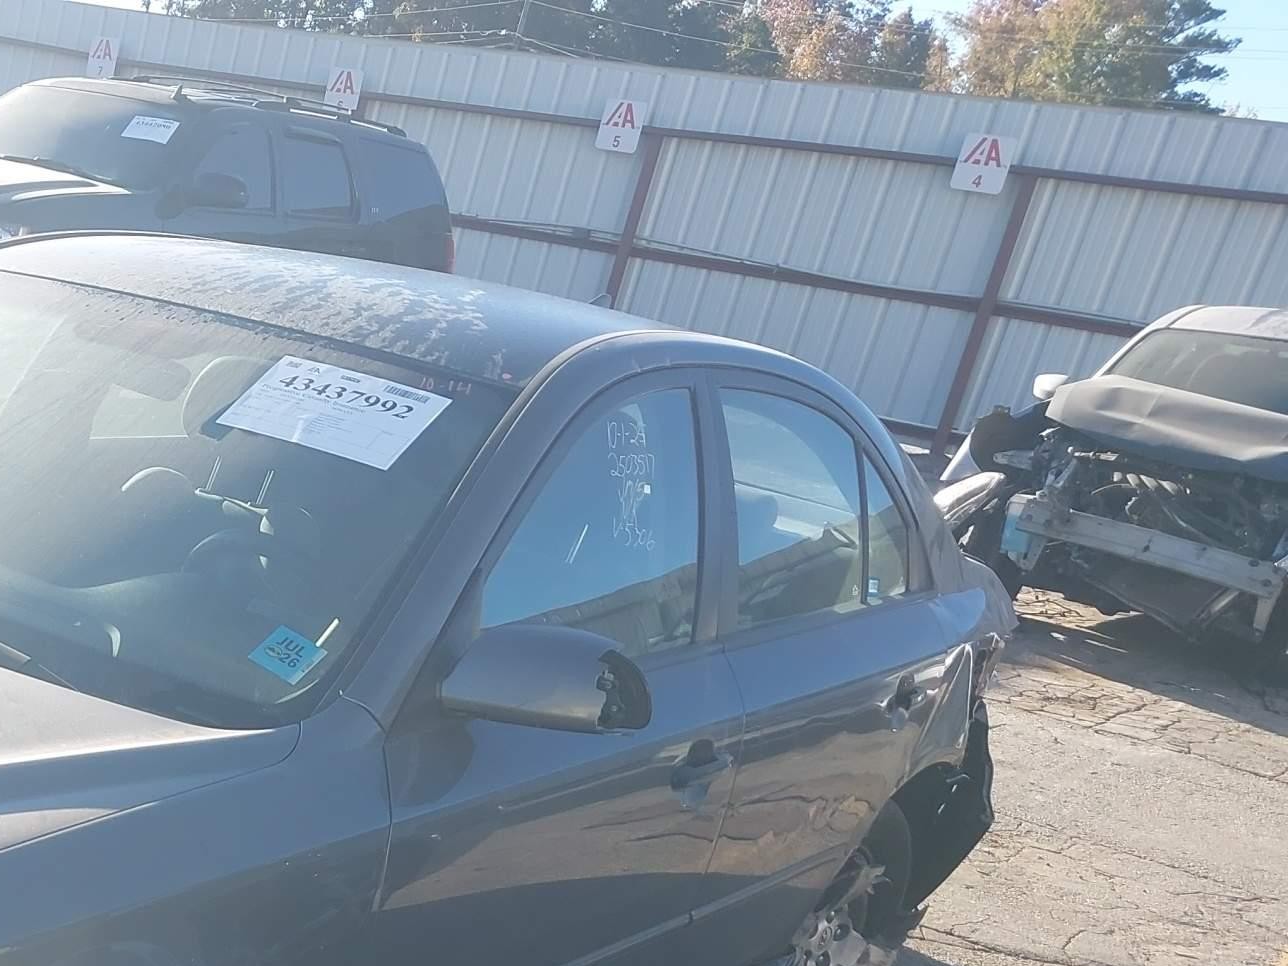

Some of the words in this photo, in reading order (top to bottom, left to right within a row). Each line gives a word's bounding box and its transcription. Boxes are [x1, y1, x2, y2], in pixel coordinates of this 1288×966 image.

[612, 135, 622, 148] 5
[971, 174, 983, 188] 4
[279, 375, 414, 419] 43437992
[276, 637, 305, 658] JUL
[278, 653, 300, 668] 26
